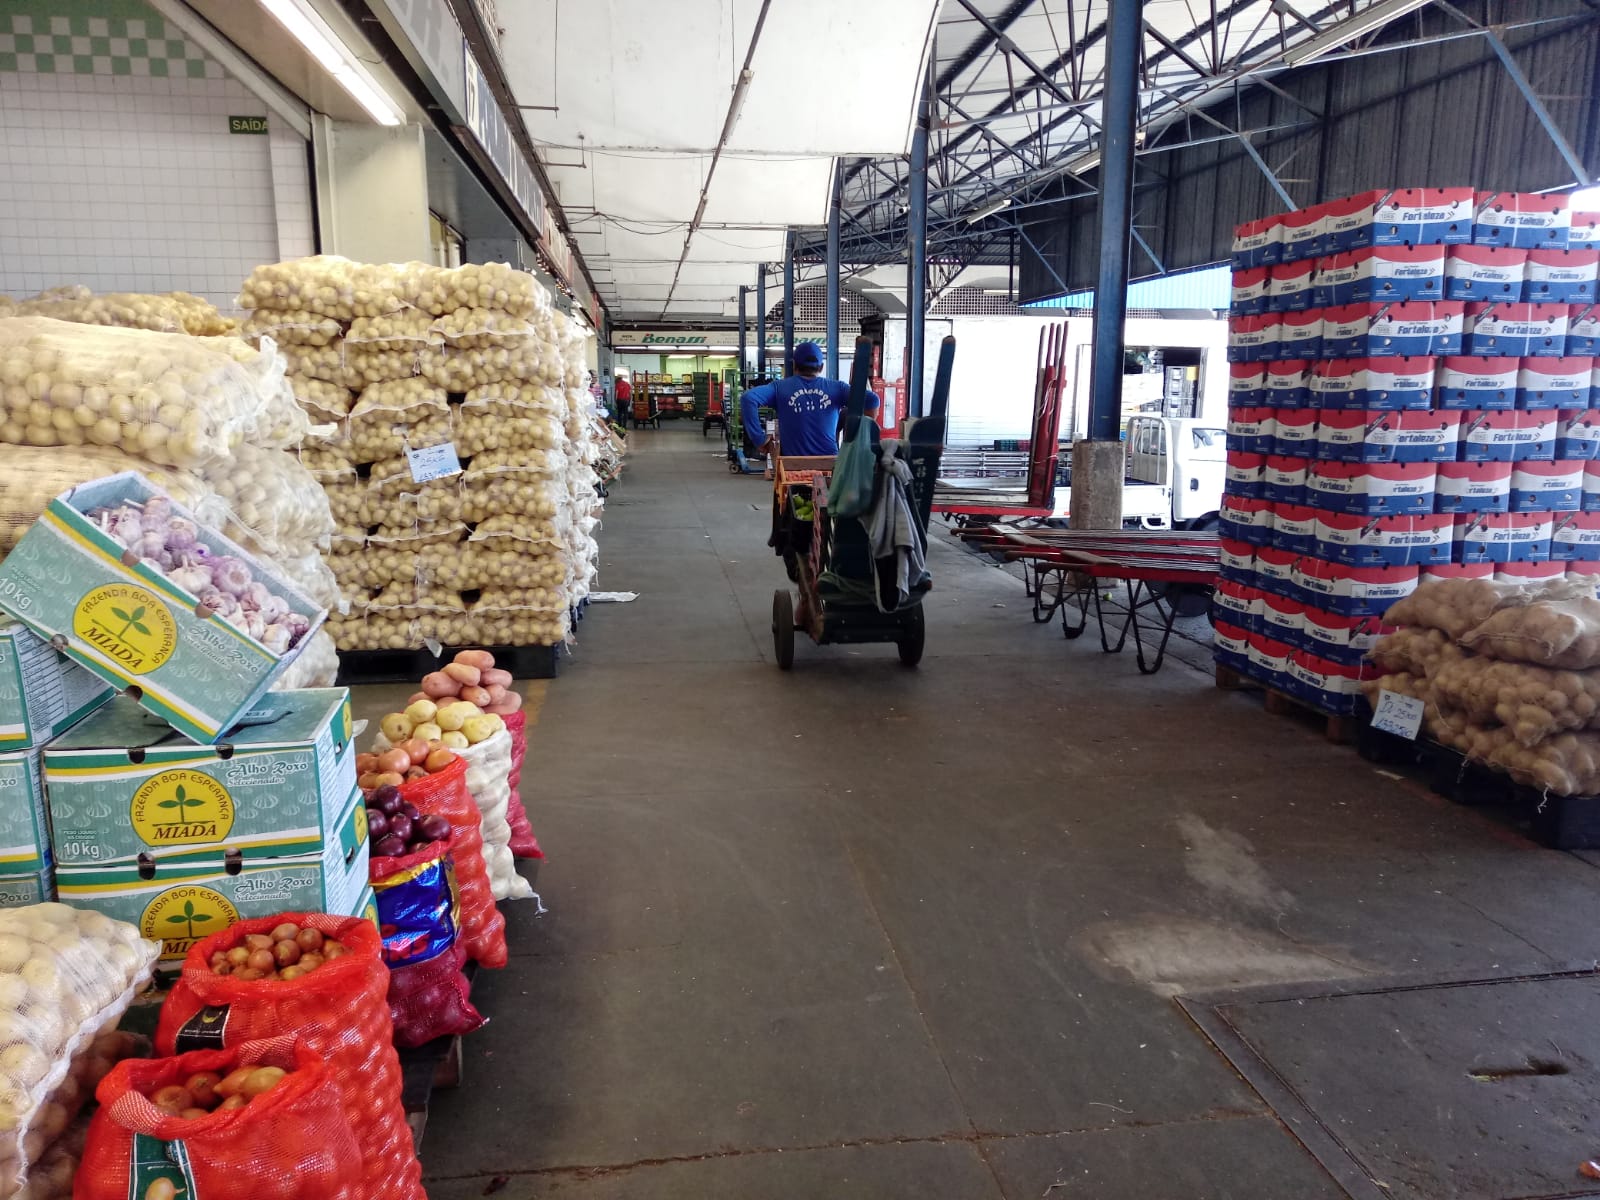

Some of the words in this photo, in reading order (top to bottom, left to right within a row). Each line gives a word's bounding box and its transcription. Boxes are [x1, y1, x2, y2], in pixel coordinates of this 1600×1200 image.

[82, 588, 128, 614] FAZENDA
[131, 592, 156, 609] BOA
[81, 627, 143, 668] MIADA
[189, 625, 225, 650] Alho
[227, 649, 258, 673] Roxo
[227, 764, 267, 778] Alho
[272, 761, 307, 774] Roxo
[135, 780, 160, 822] FAZENDA
[161, 772, 187, 784] BOA
[190, 774, 230, 820] ESPERANÇA
[152, 824, 217, 840] MIADA
[235, 879, 274, 893] Alho
[279, 877, 313, 889] Roxo
[145, 897, 169, 938] FAZENDA
[171, 888, 196, 900] BOA
